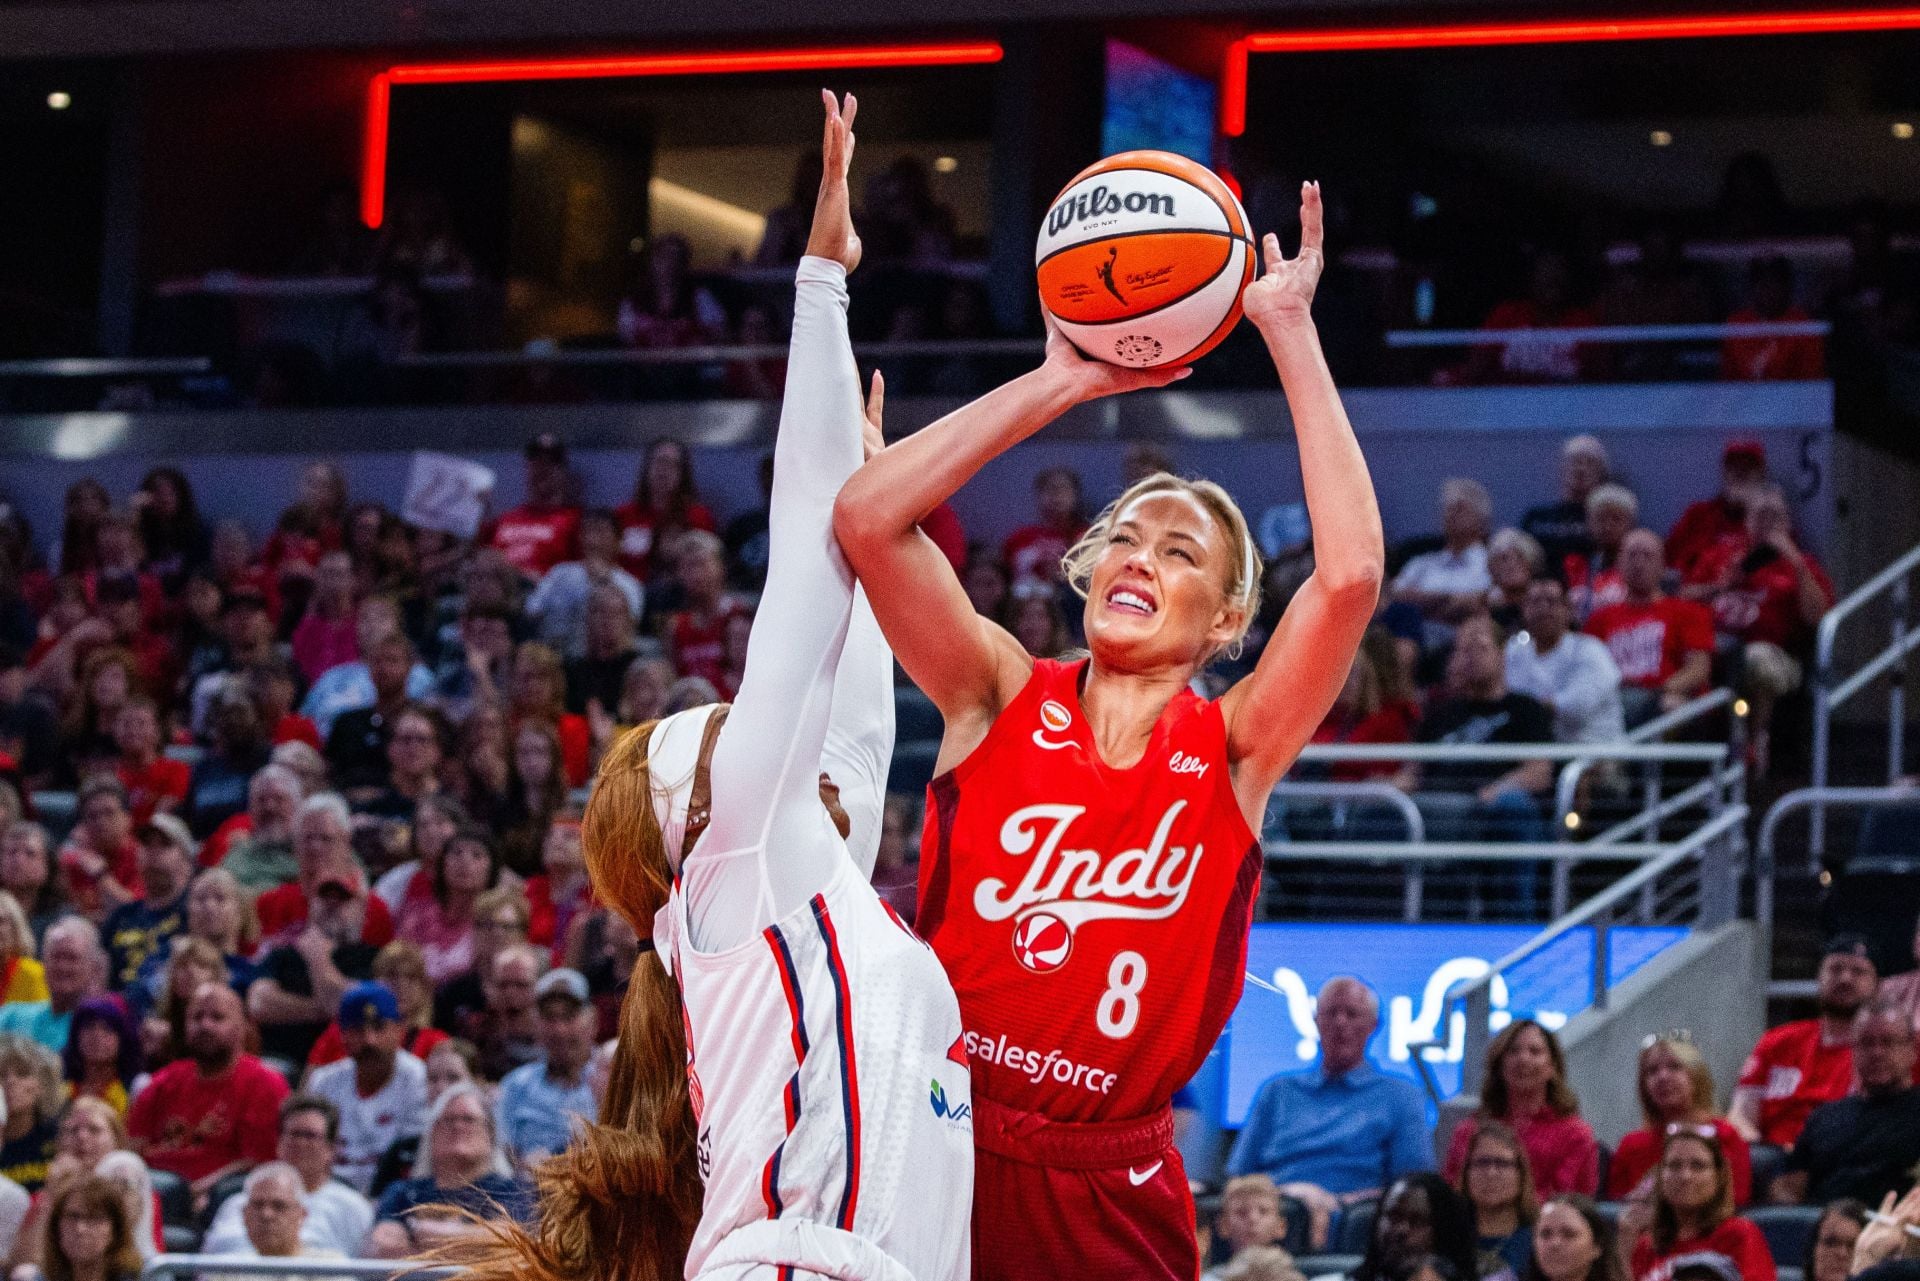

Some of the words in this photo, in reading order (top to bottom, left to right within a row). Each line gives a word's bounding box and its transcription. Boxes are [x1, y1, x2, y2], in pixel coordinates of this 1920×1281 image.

[1049, 185, 1176, 237] Wilson
[1083, 223, 1099, 231] EVO
[973, 799, 1203, 930] Indy
[1095, 950, 1149, 1040] 8
[965, 1030, 1118, 1095] salesforce
